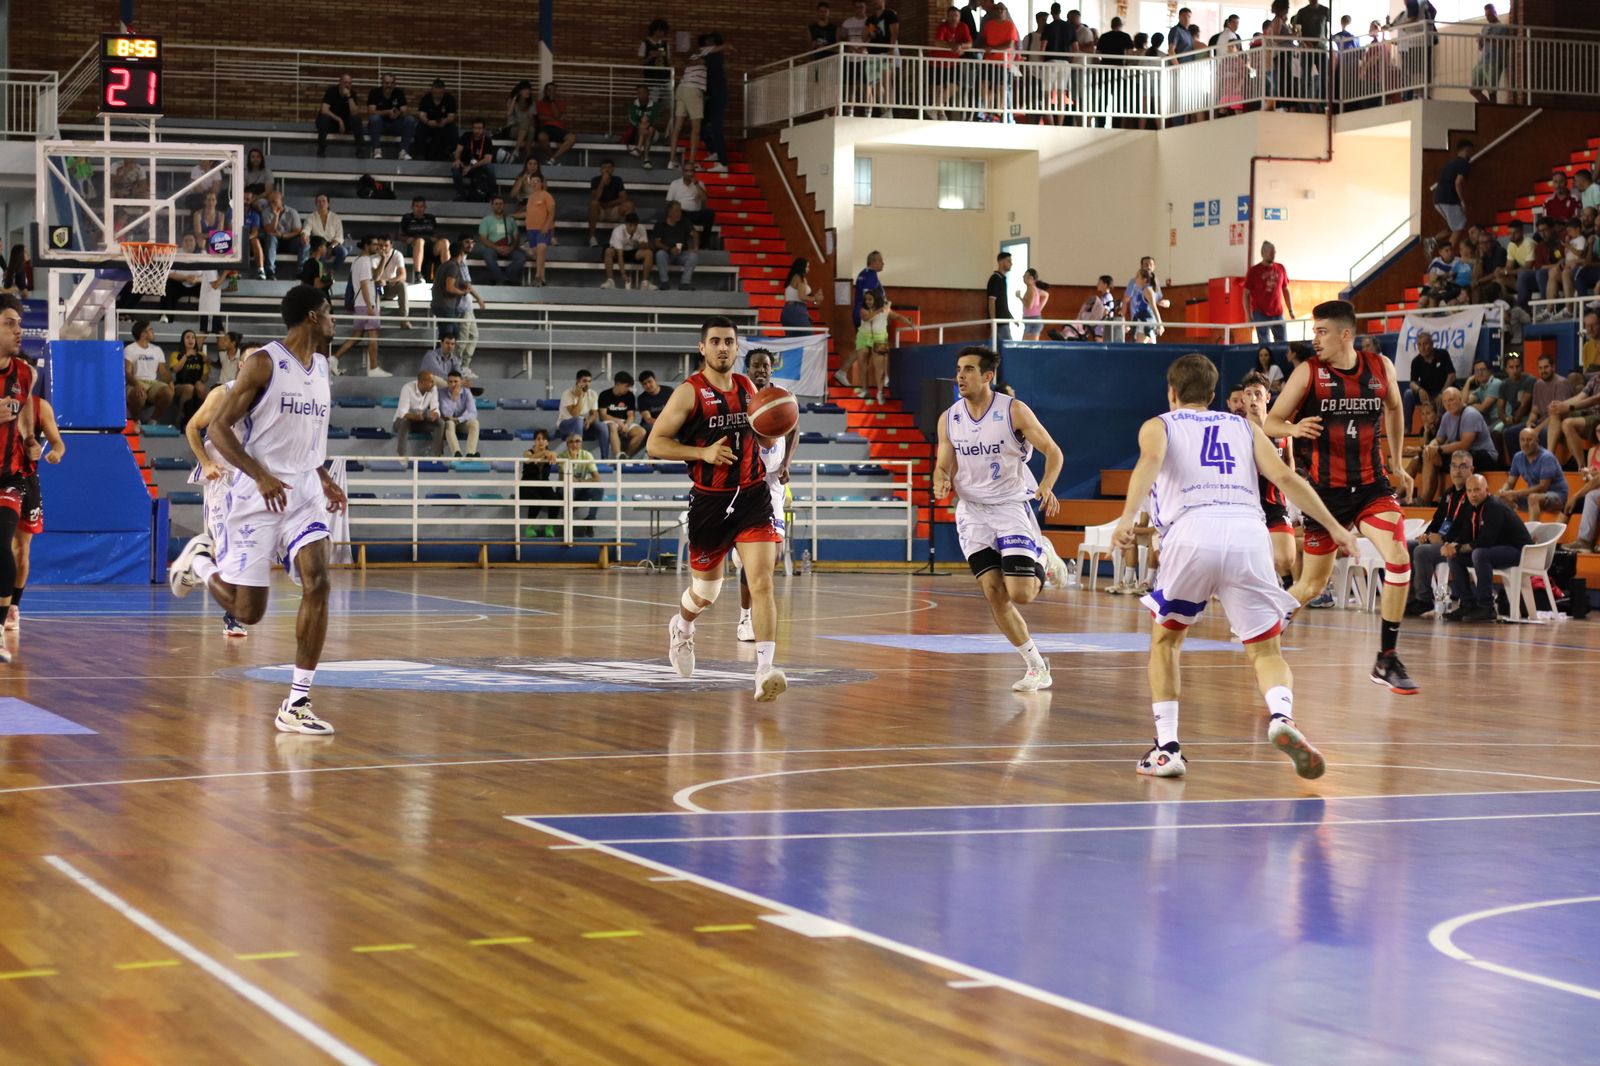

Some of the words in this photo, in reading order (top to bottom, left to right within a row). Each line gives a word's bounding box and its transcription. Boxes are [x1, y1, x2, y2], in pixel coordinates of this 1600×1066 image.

[117, 39, 157, 57] 8:56
[106, 67, 157, 107] 21
[1405, 323, 1466, 351] Helva
[1321, 399, 1337, 412] CB
[1339, 397, 1381, 411] PUERTO
[708, 415, 724, 428] CB
[726, 412, 749, 425] PUER
[1346, 419, 1357, 439] 4
[734, 431, 740, 450] 1
[1200, 425, 1236, 475] 4
[990, 462, 1002, 480] 2
[1003, 537, 1030, 545] Huelva
